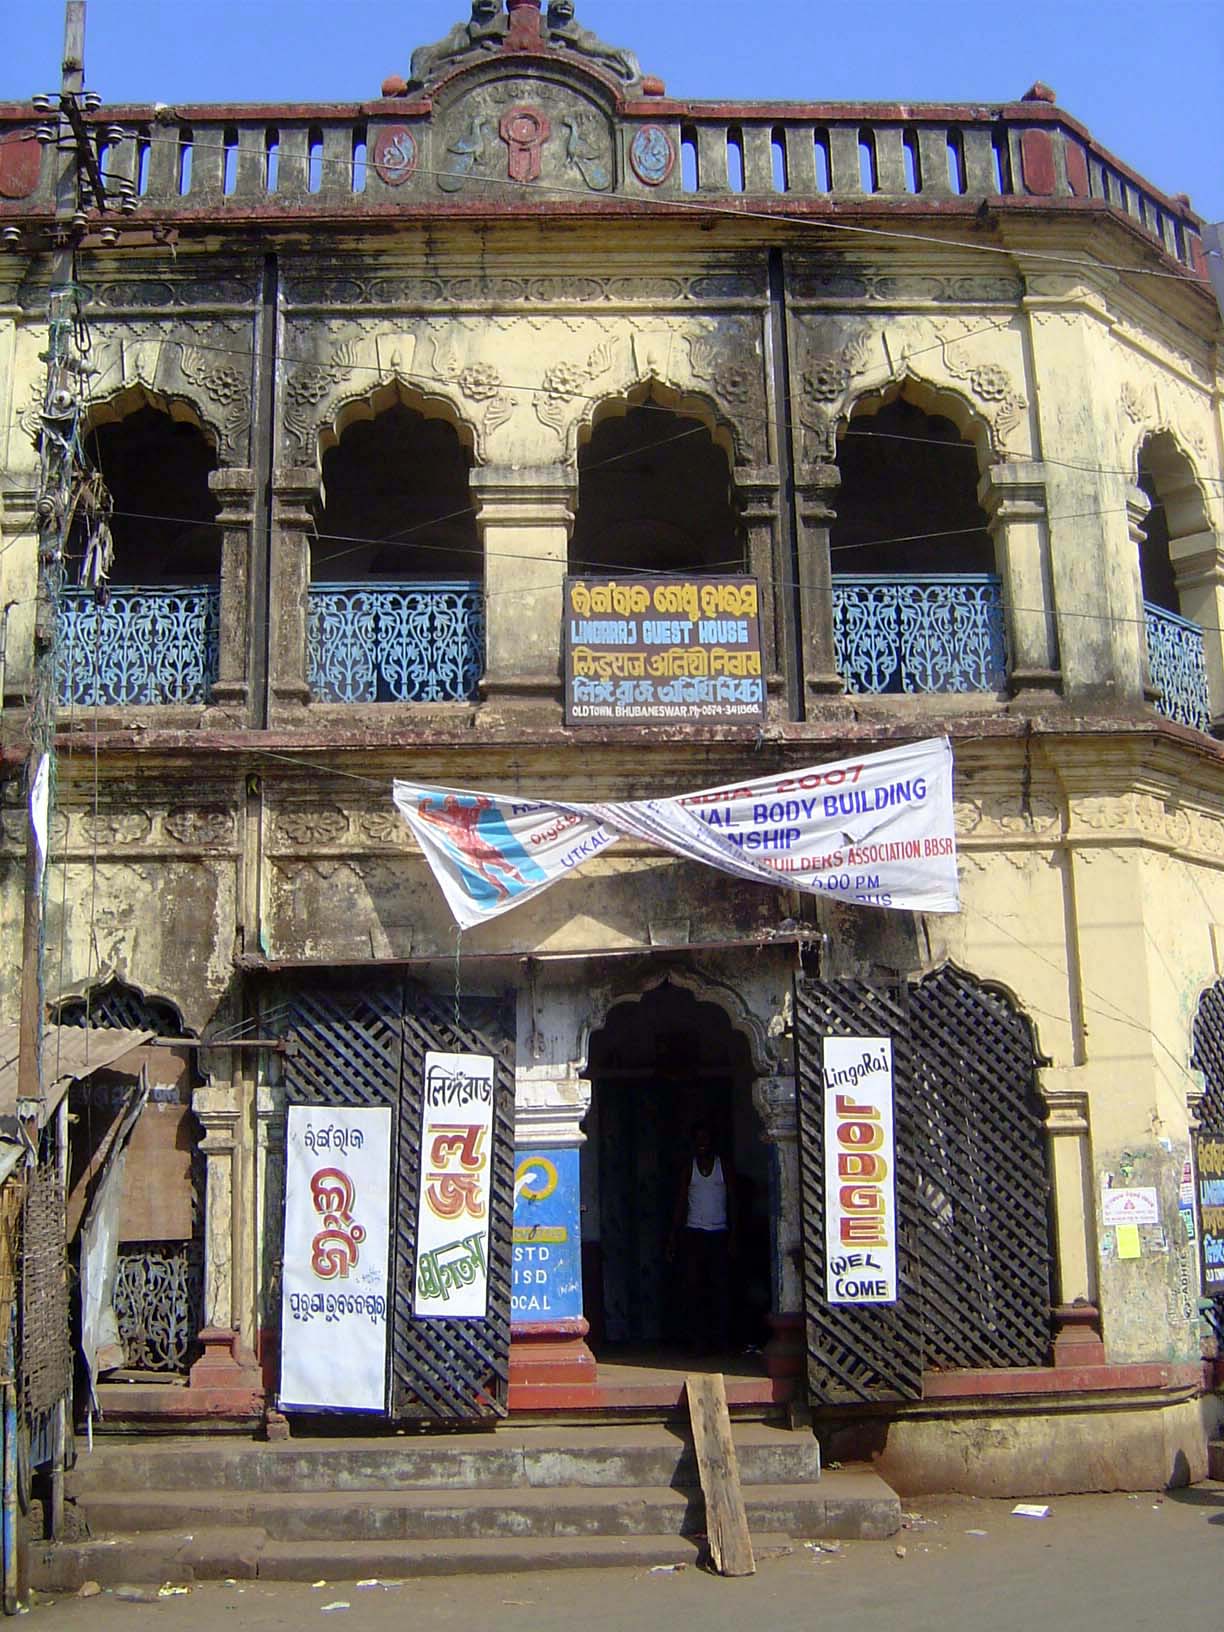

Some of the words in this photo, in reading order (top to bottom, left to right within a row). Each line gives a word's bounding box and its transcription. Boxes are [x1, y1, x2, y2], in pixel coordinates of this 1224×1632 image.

[571, 620, 637, 645] LINGARAJ
[642, 620, 694, 644] GUEST
[699, 620, 748, 644] HOUSE
[775, 764, 866, 794] 2007
[753, 798, 817, 826] BODY
[823, 778, 927, 816] BUILDING
[560, 832, 609, 868] UTKAL
[925, 837, 954, 857] BBSR
[856, 875, 880, 889] PM
[822, 1047, 889, 1090] LingaRaj
[835, 1094, 888, 1248] LODGE
[513, 1246, 550, 1262] STD
[514, 1269, 548, 1285] ISD
[835, 1277, 888, 1298] COME
